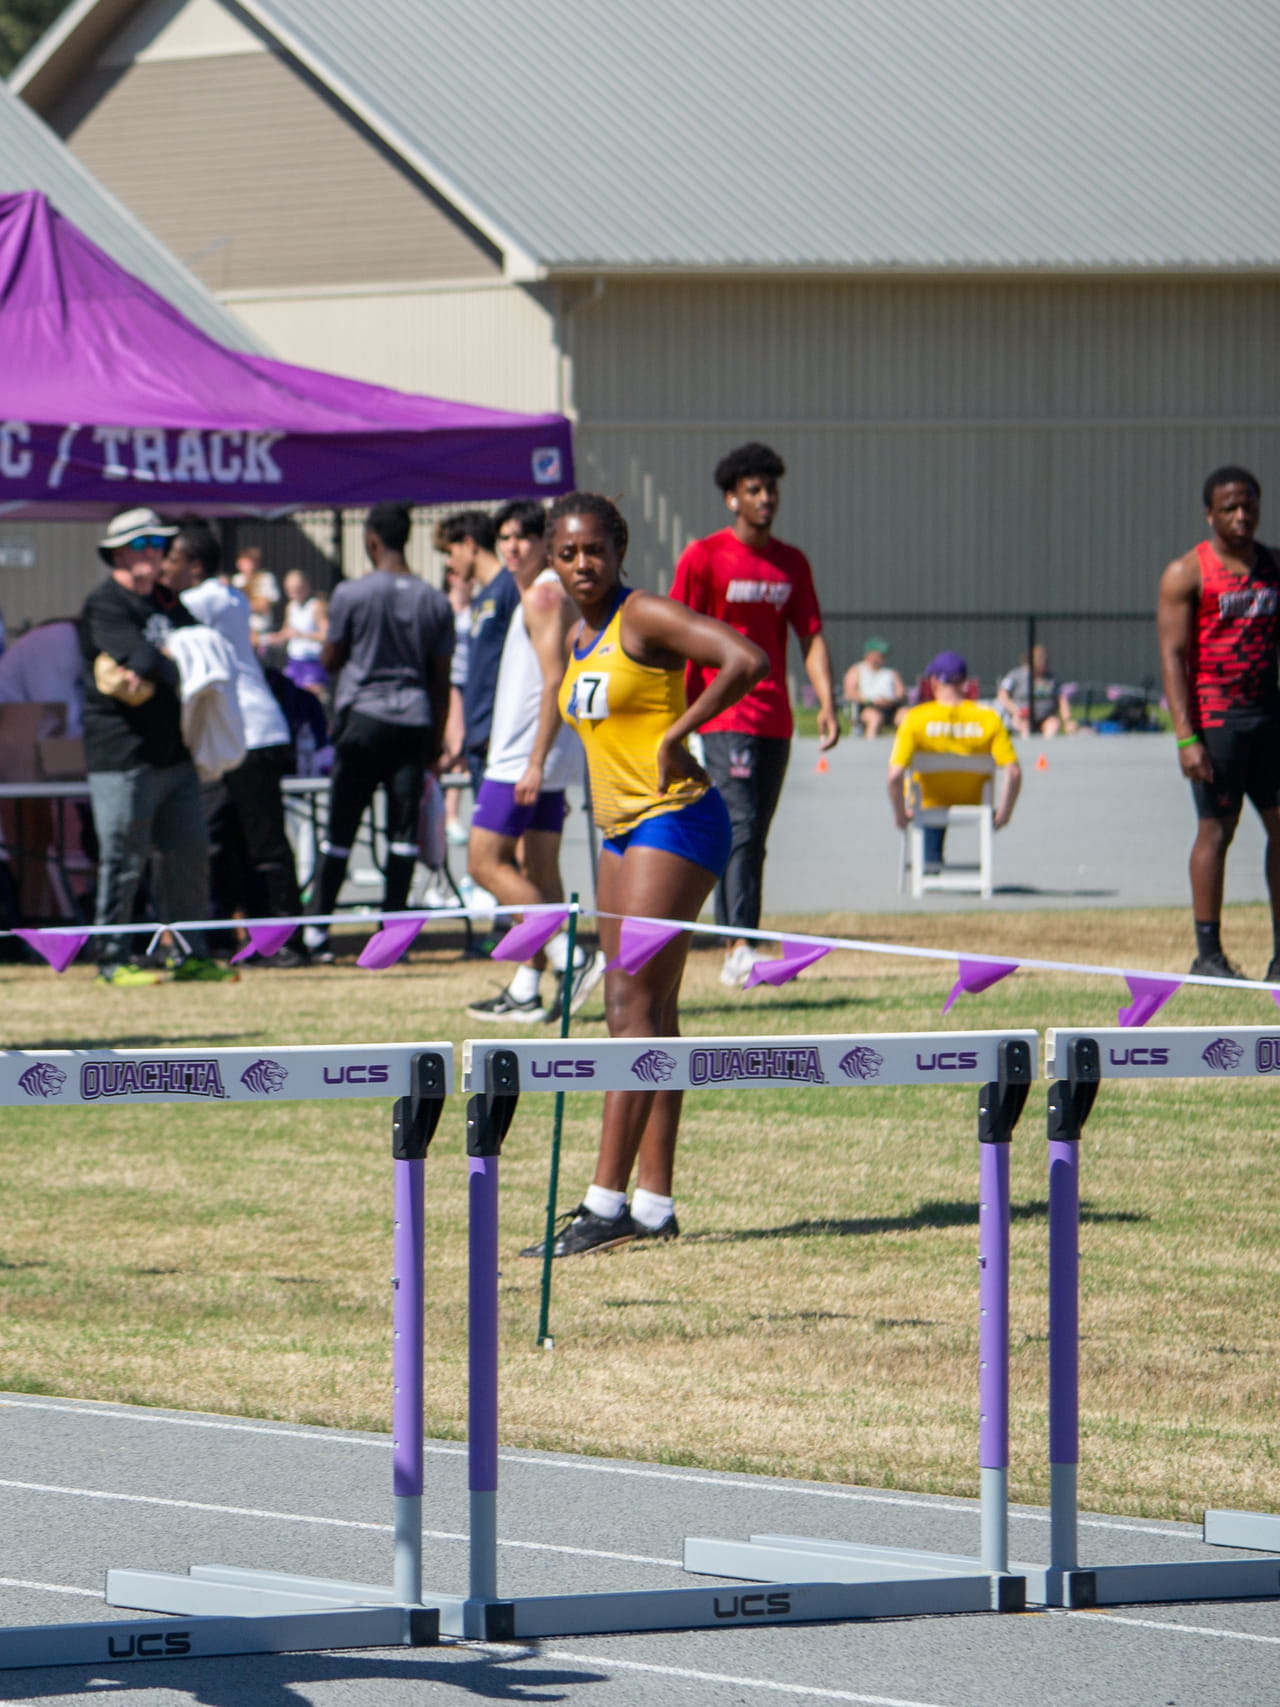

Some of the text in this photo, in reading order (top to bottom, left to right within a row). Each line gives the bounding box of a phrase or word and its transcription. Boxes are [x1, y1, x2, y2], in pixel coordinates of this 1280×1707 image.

[92, 425, 285, 483] TRACK
[583, 677, 602, 714] 7
[531, 1046, 979, 1086] UCS OUACHITA UCS
[1110, 1048, 1171, 1065] UCS
[80, 1059, 226, 1100] OUACHITA
[323, 1064, 390, 1085] UCS
[713, 1592, 792, 1618] UCS
[108, 1631, 192, 1658] UCS
